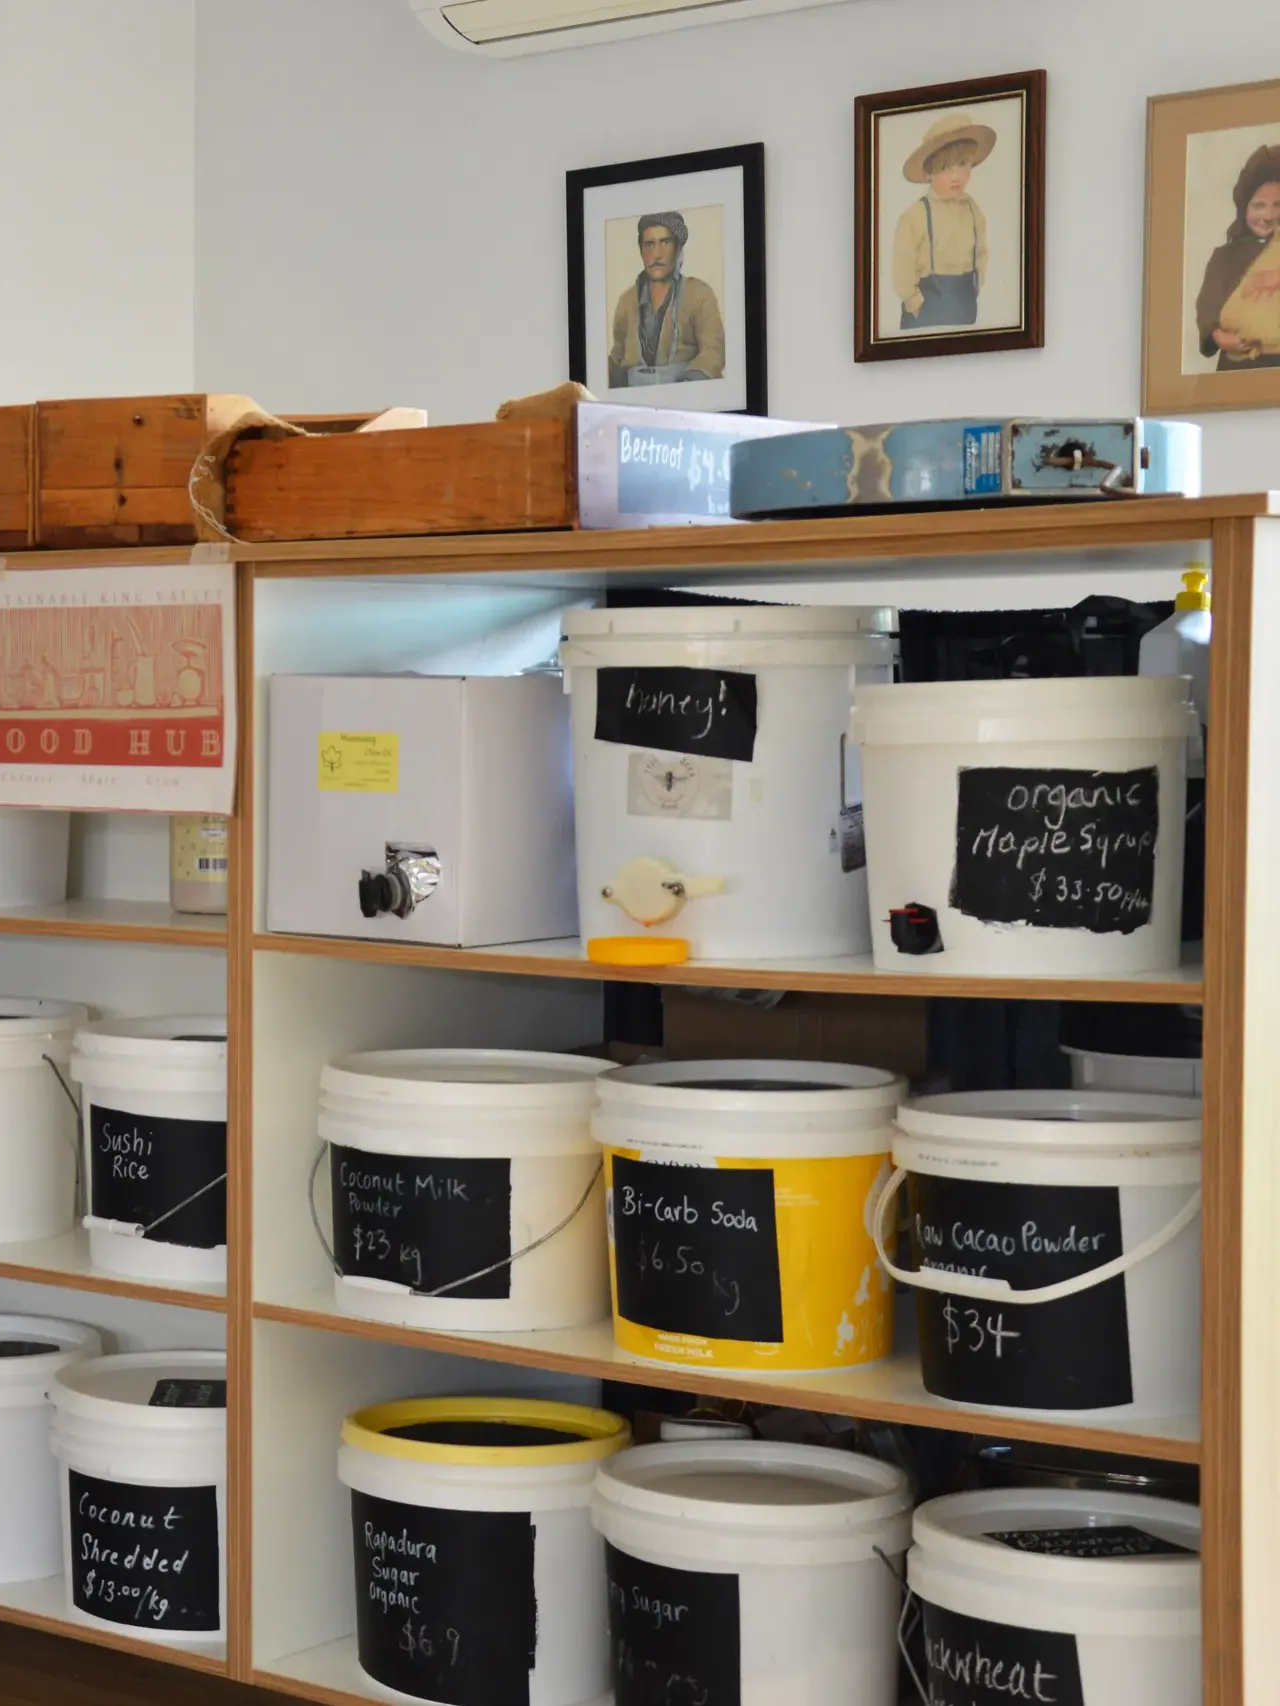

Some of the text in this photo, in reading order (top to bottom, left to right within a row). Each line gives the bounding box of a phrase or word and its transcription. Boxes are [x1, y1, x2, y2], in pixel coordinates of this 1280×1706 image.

[621, 427, 685, 470] Beetroot
[99, 588, 144, 604] KING
[155, 586, 225, 602] VALLEY
[625, 679, 728, 740] honey!
[128, 728, 220, 757] HUB
[972, 819, 1153, 871] Maple Syrup
[99, 1122, 153, 1156] Sushi
[112, 1155, 150, 1179] Rice
[339, 1161, 470, 1201] Coconut Milk
[348, 1192, 403, 1218] Powder
[710, 1200, 759, 1233] Soda
[353, 1223, 391, 1261] $23
[951, 1221, 1016, 1256] Cacao
[1021, 1220, 1107, 1253] Powder
[79, 1492, 183, 1530] Coconut
[81, 1532, 189, 1575] Shredded
[364, 1521, 438, 1564] Rapadura
[372, 1556, 420, 1592] Sugar
[631, 1585, 689, 1630] Sugar
